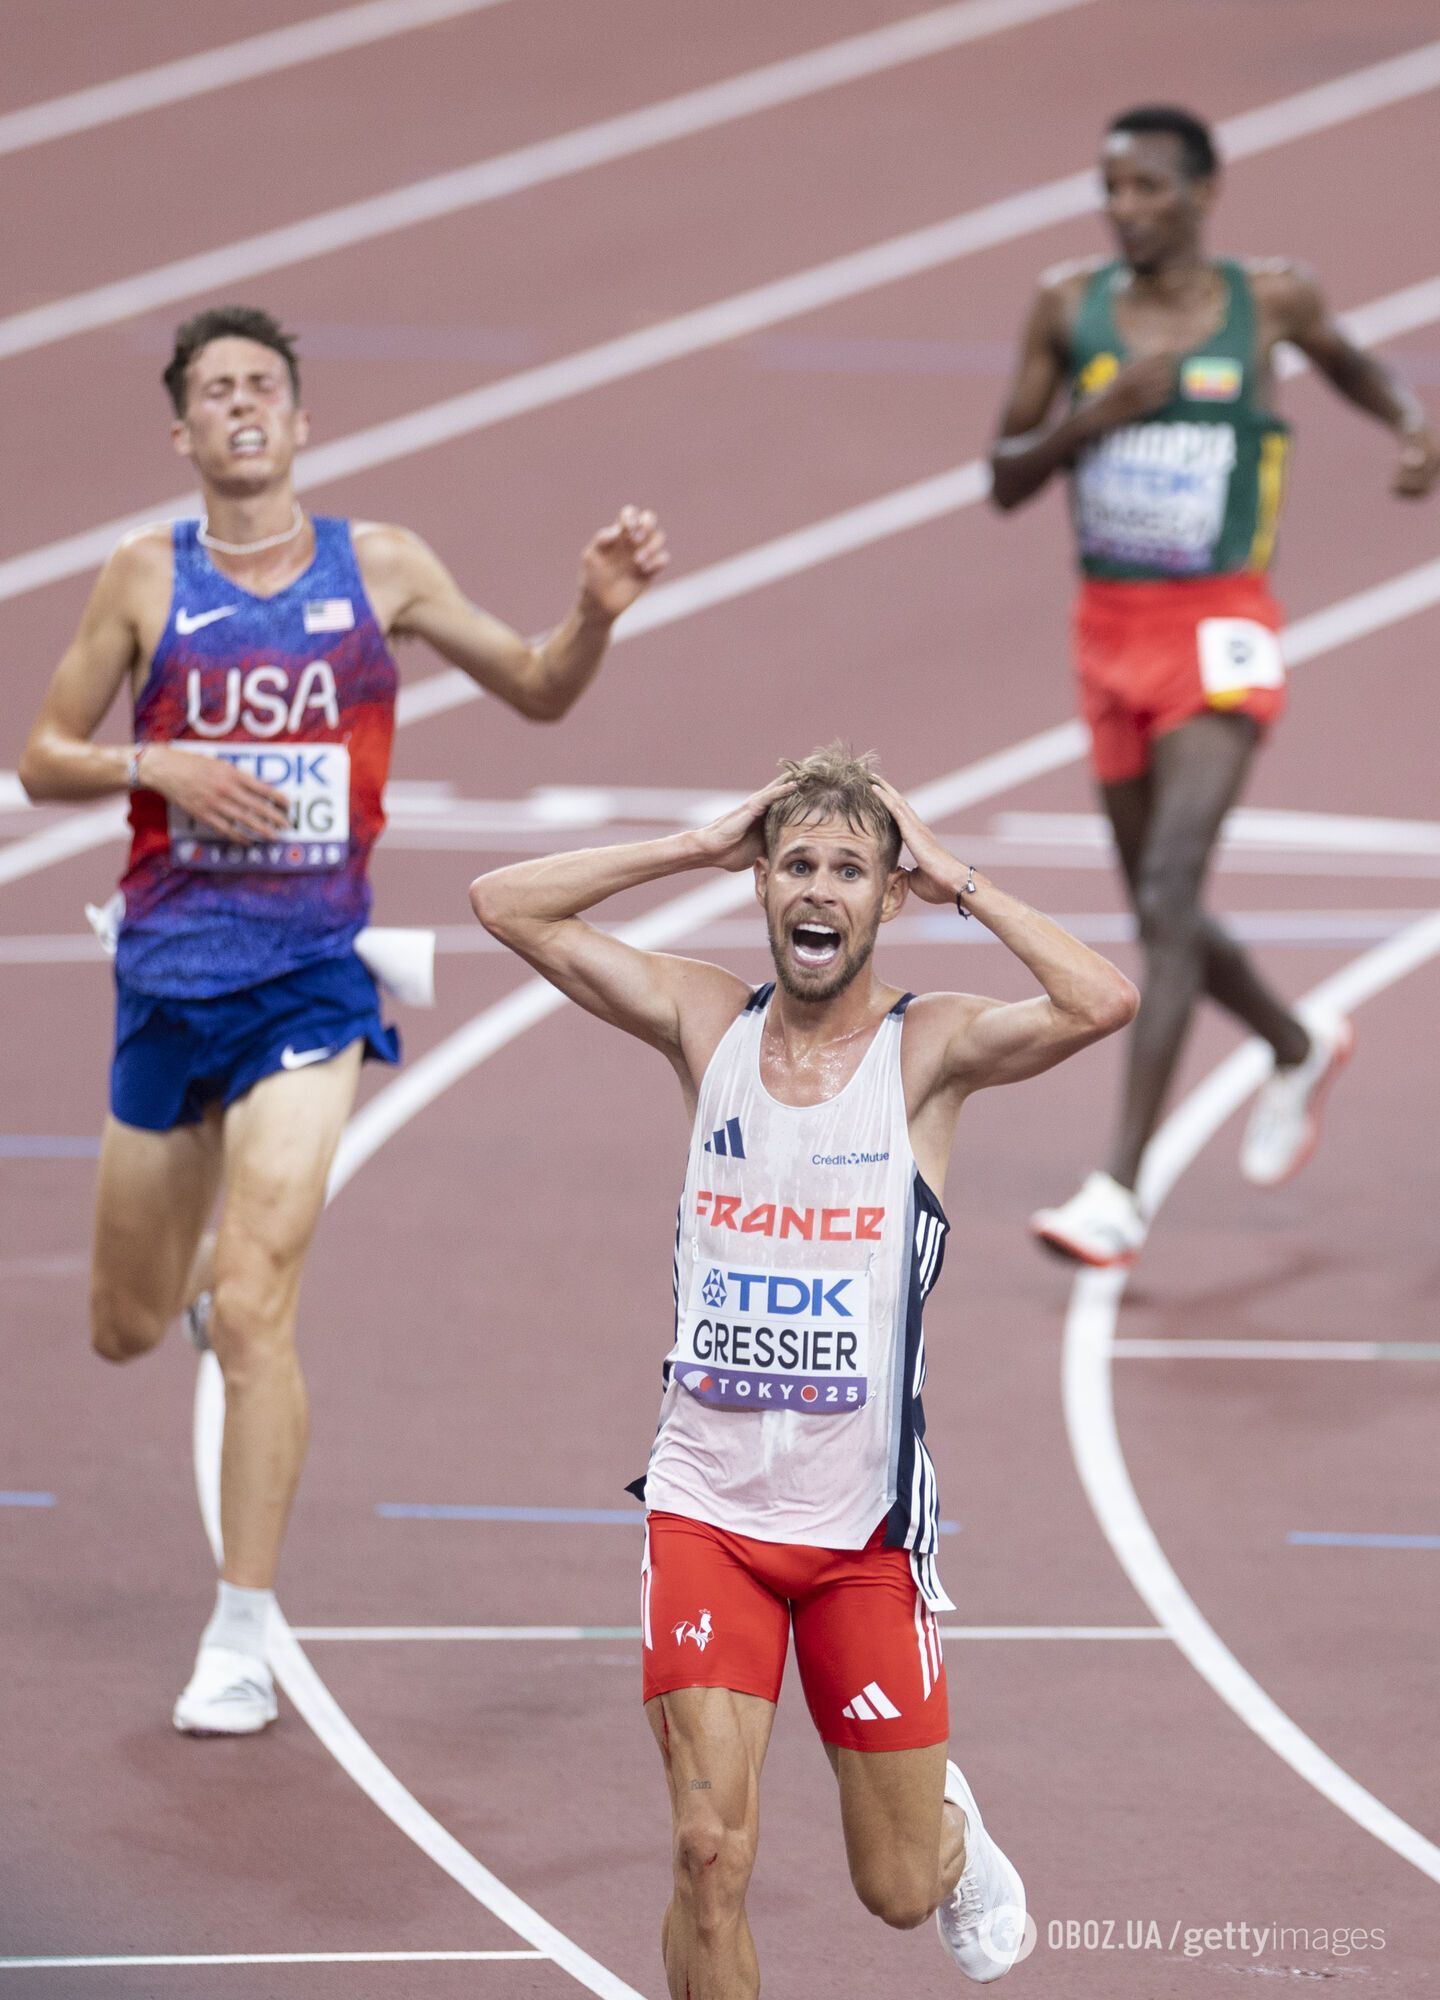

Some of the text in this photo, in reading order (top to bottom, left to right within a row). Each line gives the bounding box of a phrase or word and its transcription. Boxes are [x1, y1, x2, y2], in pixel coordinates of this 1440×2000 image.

[187, 660, 339, 738] USA
[812, 1154, 846, 1165] Crédit
[727, 1271, 854, 1317] TDK
[692, 1319, 858, 1371] GRESSIER
